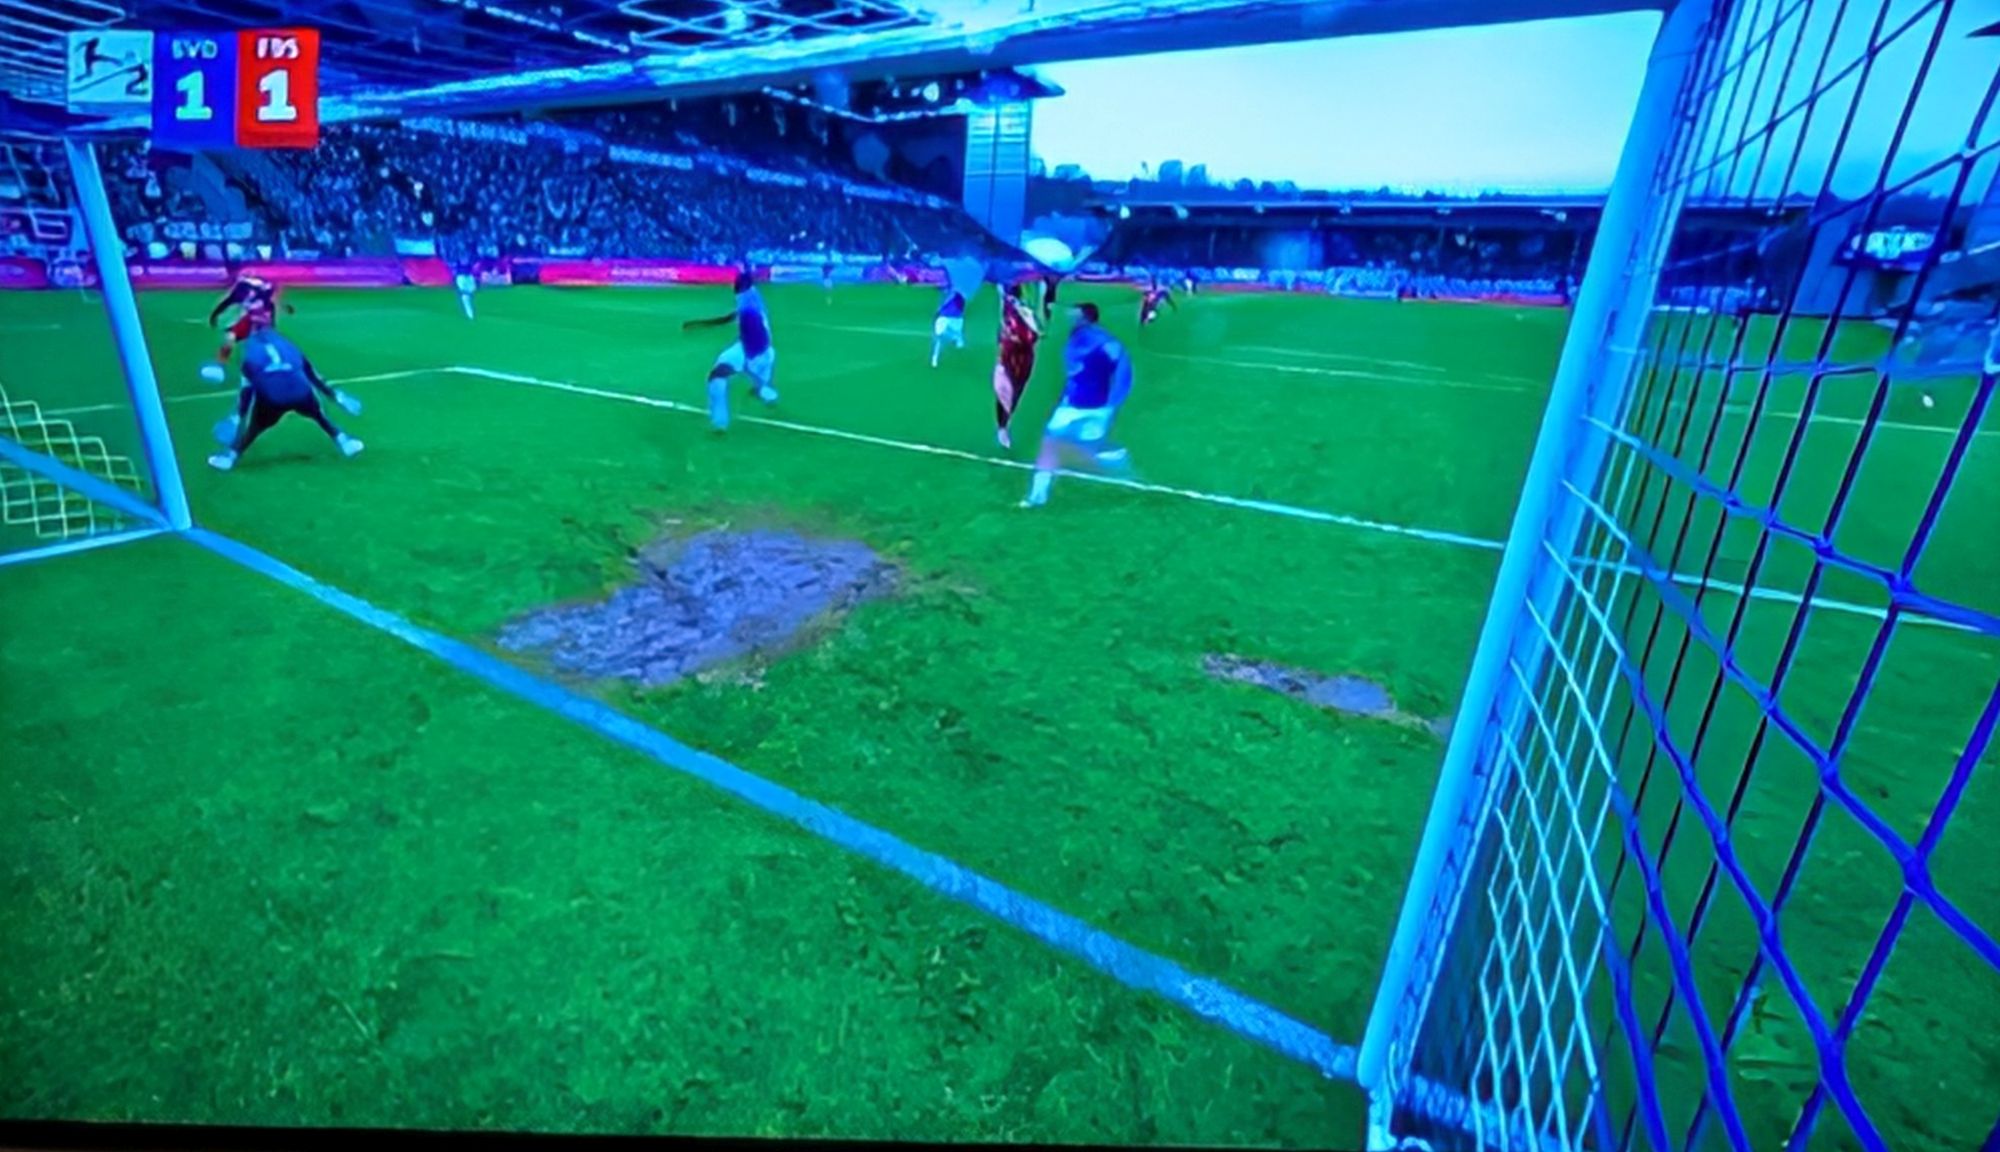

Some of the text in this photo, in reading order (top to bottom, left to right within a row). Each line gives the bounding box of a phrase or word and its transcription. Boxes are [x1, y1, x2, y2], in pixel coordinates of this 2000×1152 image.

[126, 64, 148, 95] 2
[175, 70, 212, 120] 1
[257, 69, 297, 121] 1
